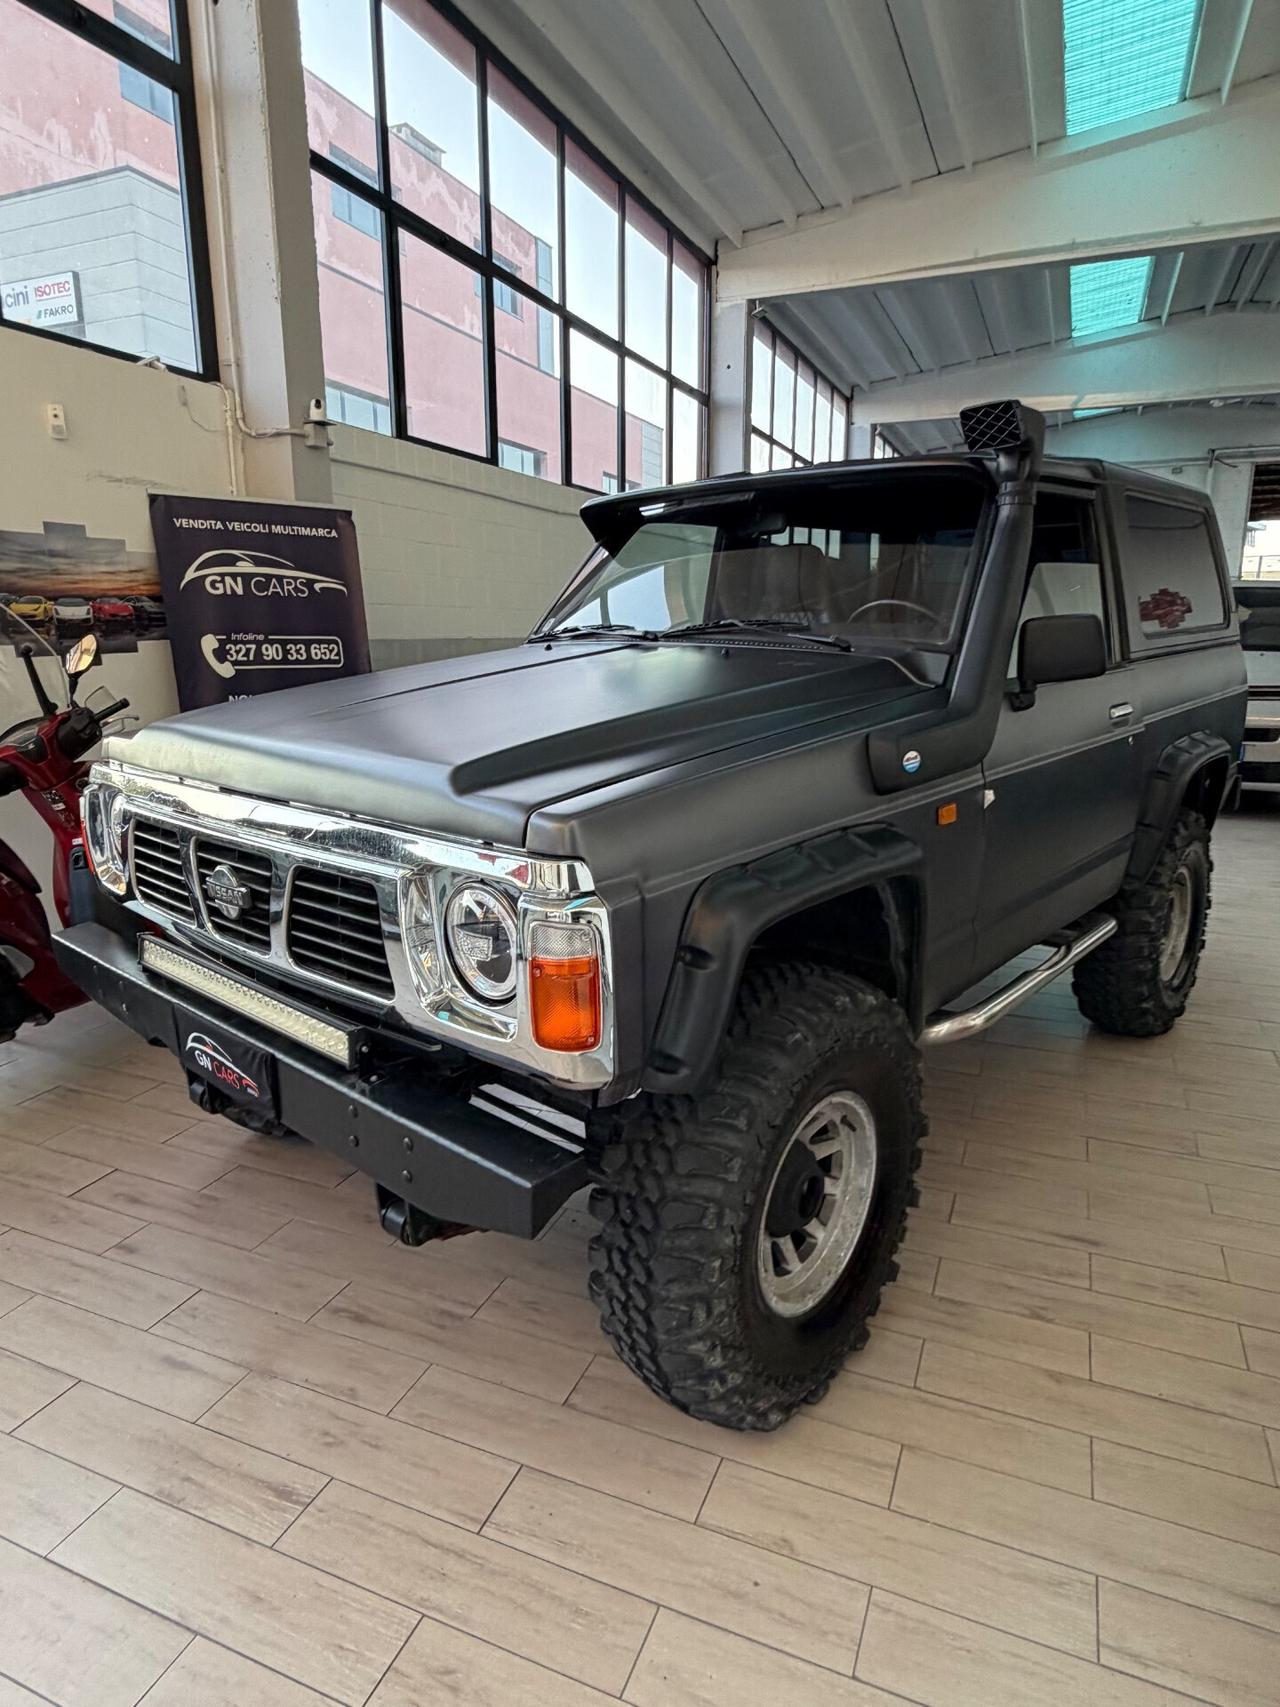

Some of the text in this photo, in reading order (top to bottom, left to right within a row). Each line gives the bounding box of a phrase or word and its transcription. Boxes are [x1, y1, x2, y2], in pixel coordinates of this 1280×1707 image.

[34, 280, 71, 298] ISOTEC
[43, 304, 74, 319] FAKRO
[173, 518, 338, 538] VENDITA VEICOLI MULTIMARCA
[204, 575, 309, 598] GN CARS
[231, 632, 265, 641] Infoline
[225, 643, 340, 662] 327 90 33 652
[194, 1050, 240, 1089] GN CARS
